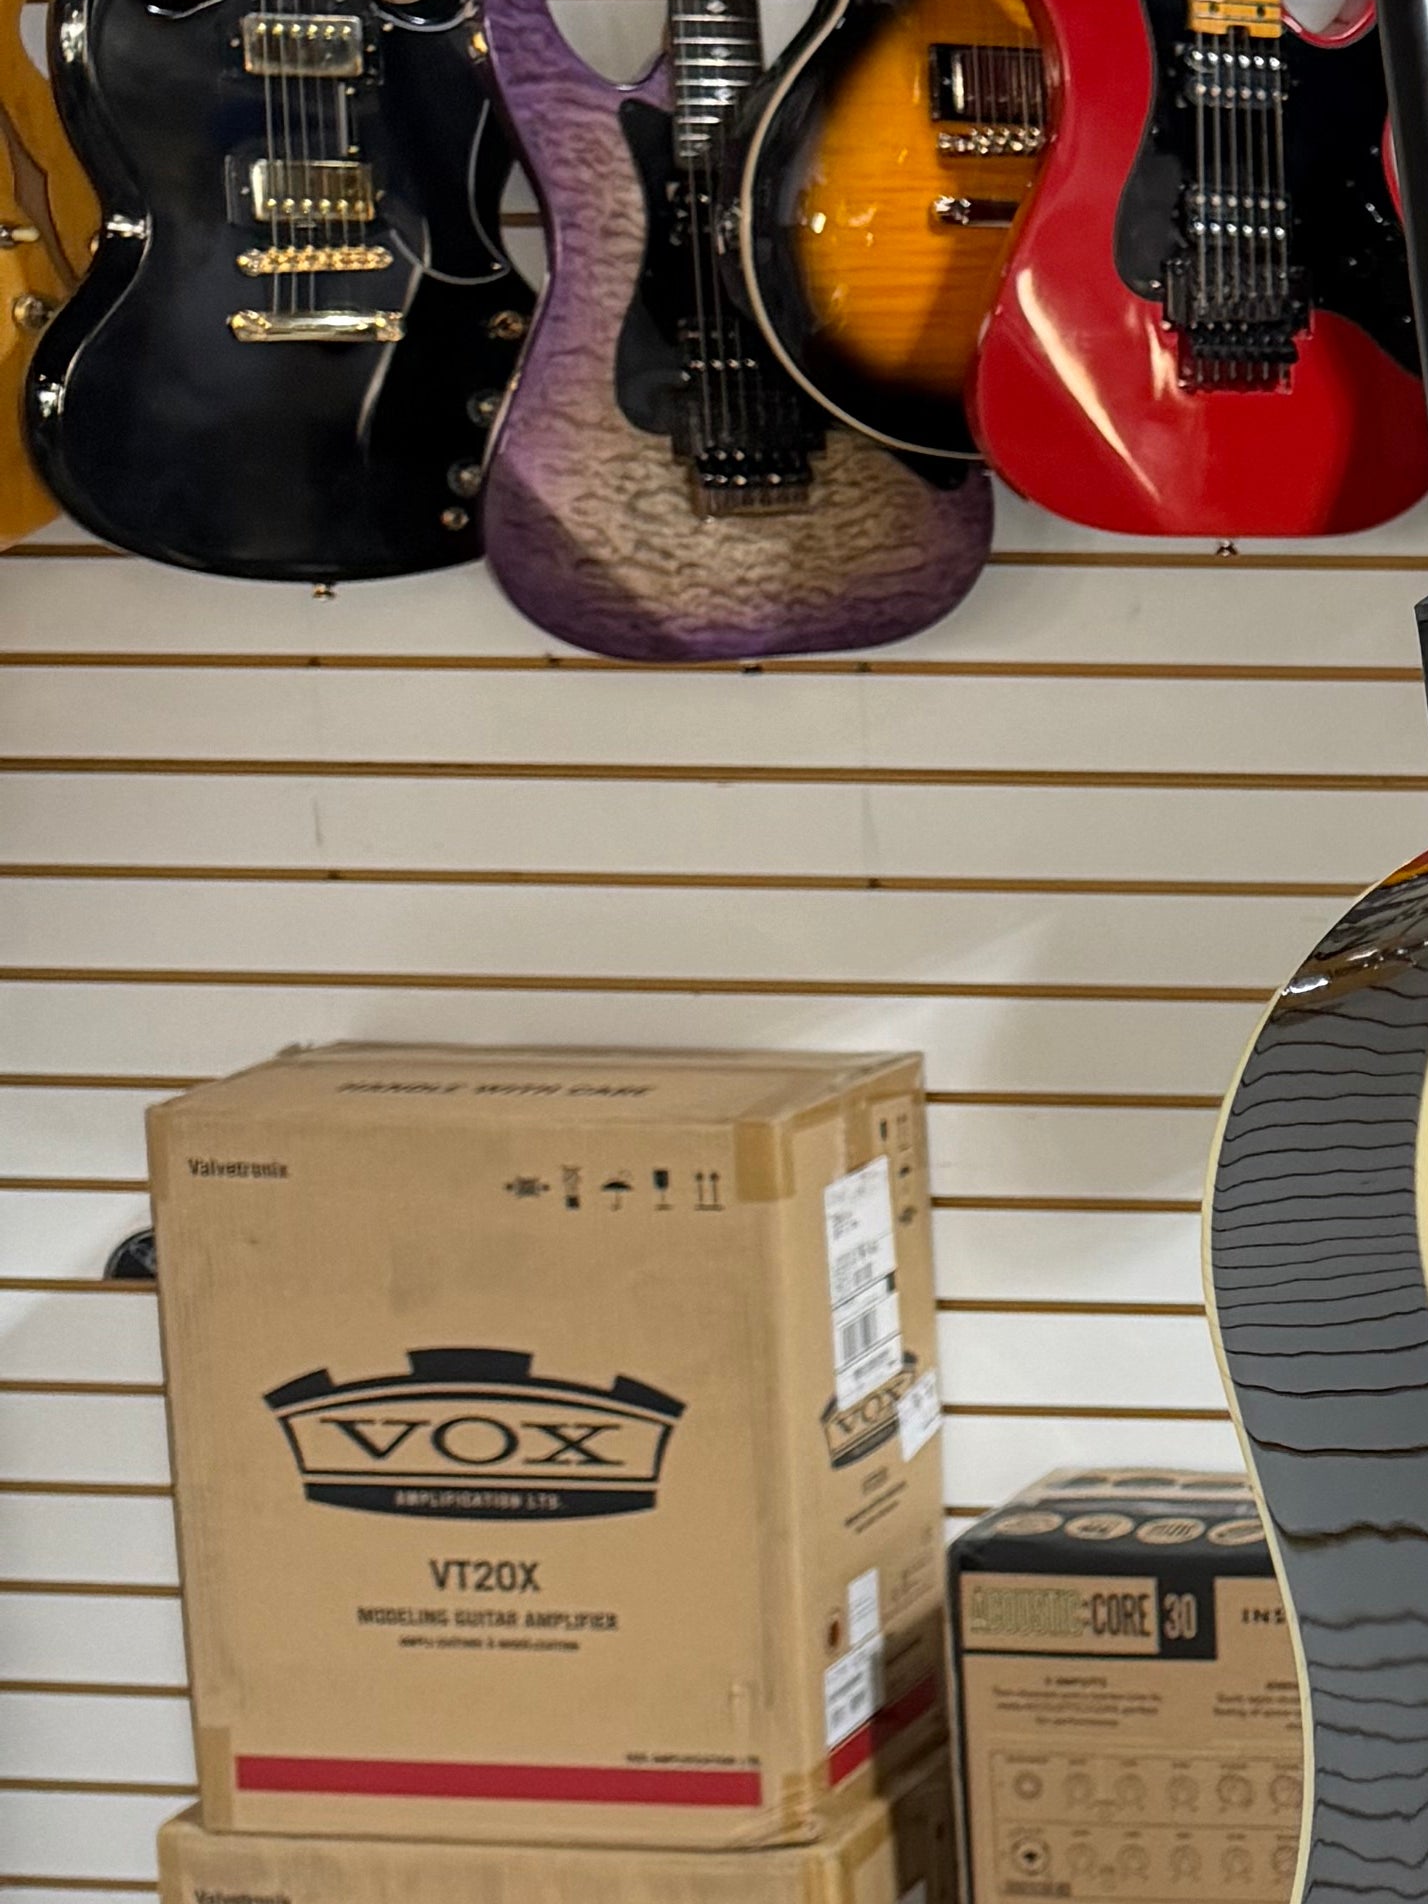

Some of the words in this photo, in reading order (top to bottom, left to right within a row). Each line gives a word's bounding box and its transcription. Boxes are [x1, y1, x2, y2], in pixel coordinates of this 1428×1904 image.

[319, 1416, 626, 1466] VOX
[428, 1559, 541, 1592] VT20X
[357, 1607, 448, 1627] MODELING
[454, 1609, 517, 1628] GUITAR
[524, 1611, 619, 1631] AMPLIFIER
[1163, 1592, 1198, 1640] 30
